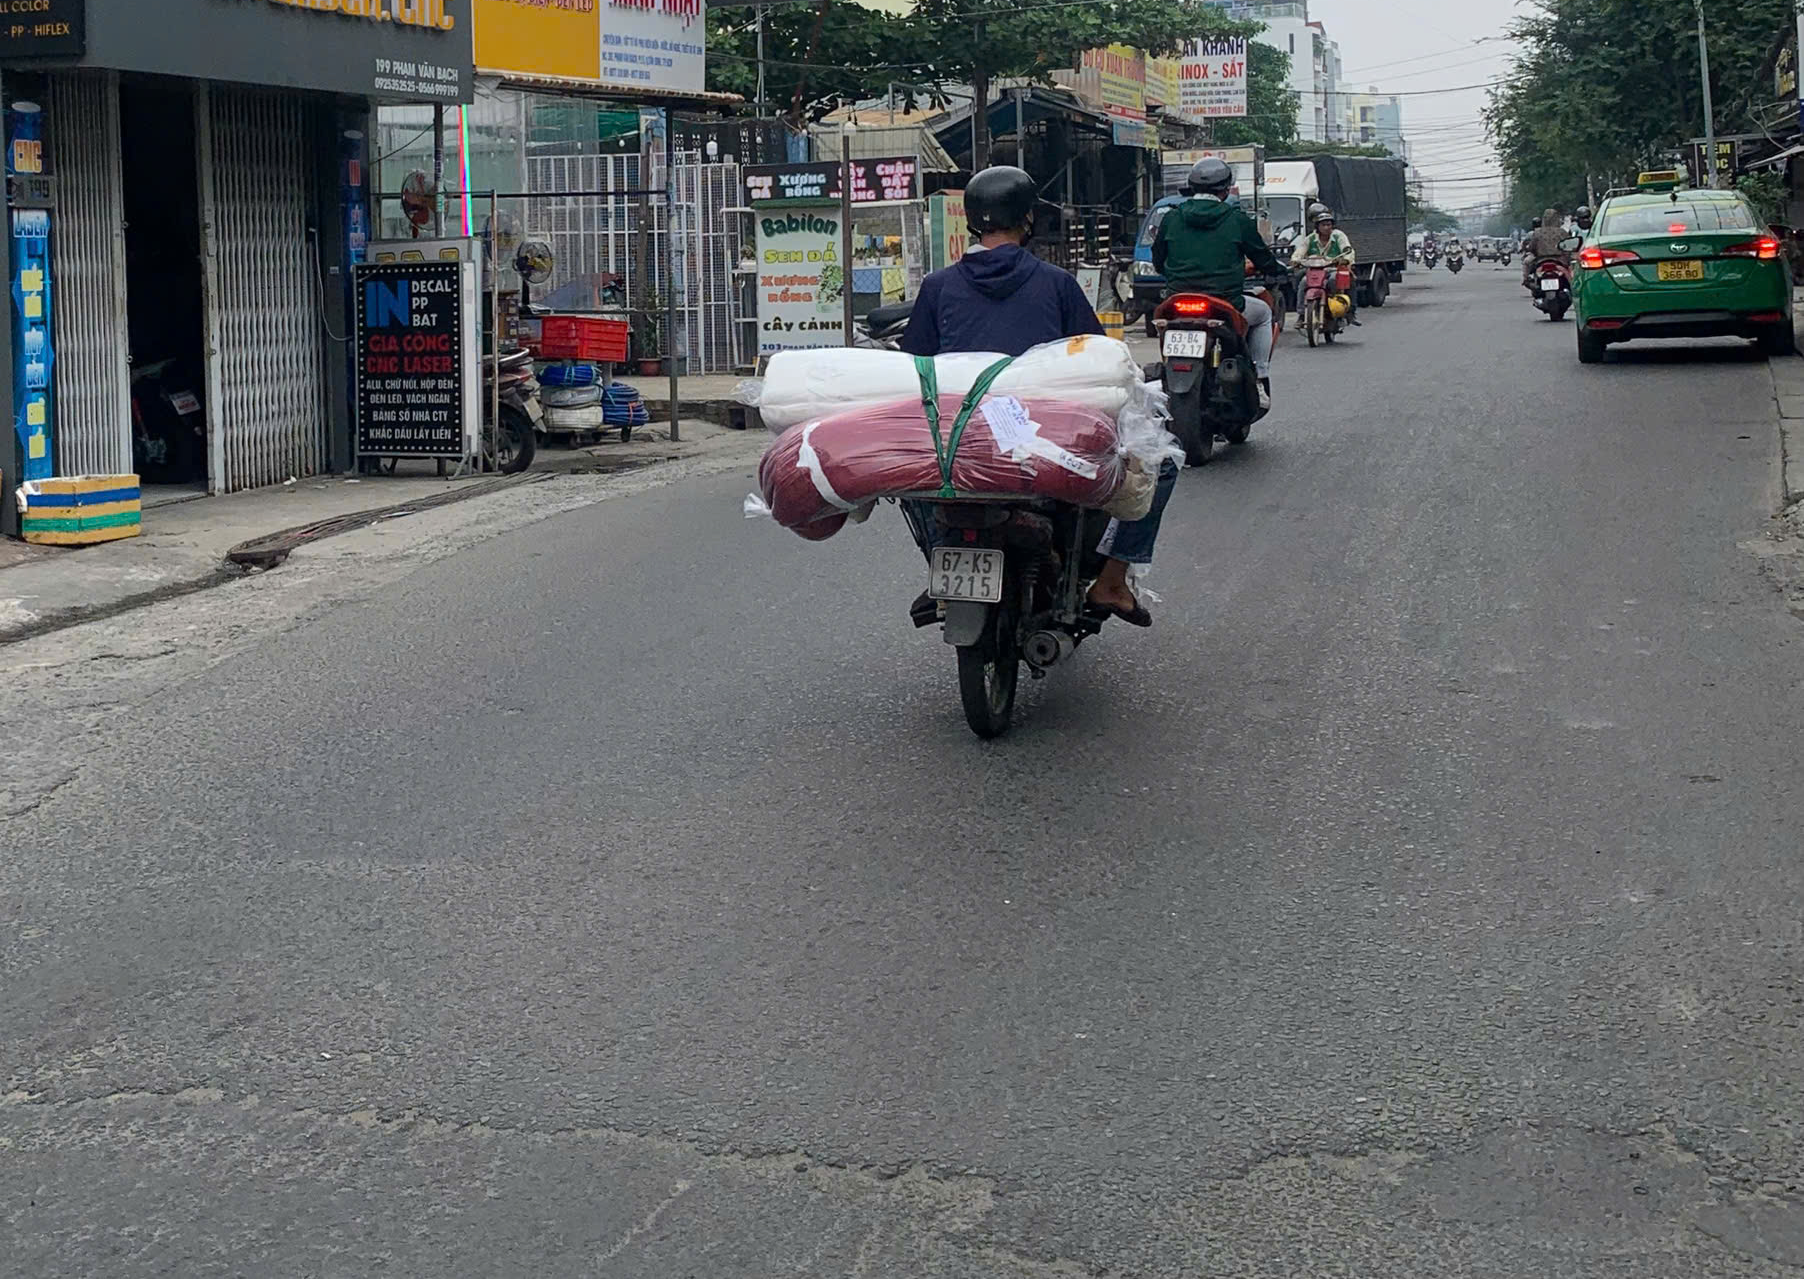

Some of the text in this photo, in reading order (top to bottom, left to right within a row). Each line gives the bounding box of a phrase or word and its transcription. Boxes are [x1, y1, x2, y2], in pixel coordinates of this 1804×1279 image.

[11, 0, 49, 13] COLOR
[34, 23, 70, 36] HIFLEX
[376, 58, 458, 82] 199 PHẠM VĂN BẠCH
[1222, 57, 1244, 78] SẮT
[760, 213, 838, 238] Babilon
[764, 241, 837, 264] SEN ĐÁ
[366, 279, 452, 328] IN DECAL
[412, 297, 428, 310] PP
[798, 317, 842, 330] CẢNH
[368, 330, 450, 352] GIA CÔNG
[367, 355, 453, 373] CNC LASER
[432, 410, 448, 421] CTY
[942, 551, 993, 574] 67-K5
[940, 574, 992, 597] 3215
